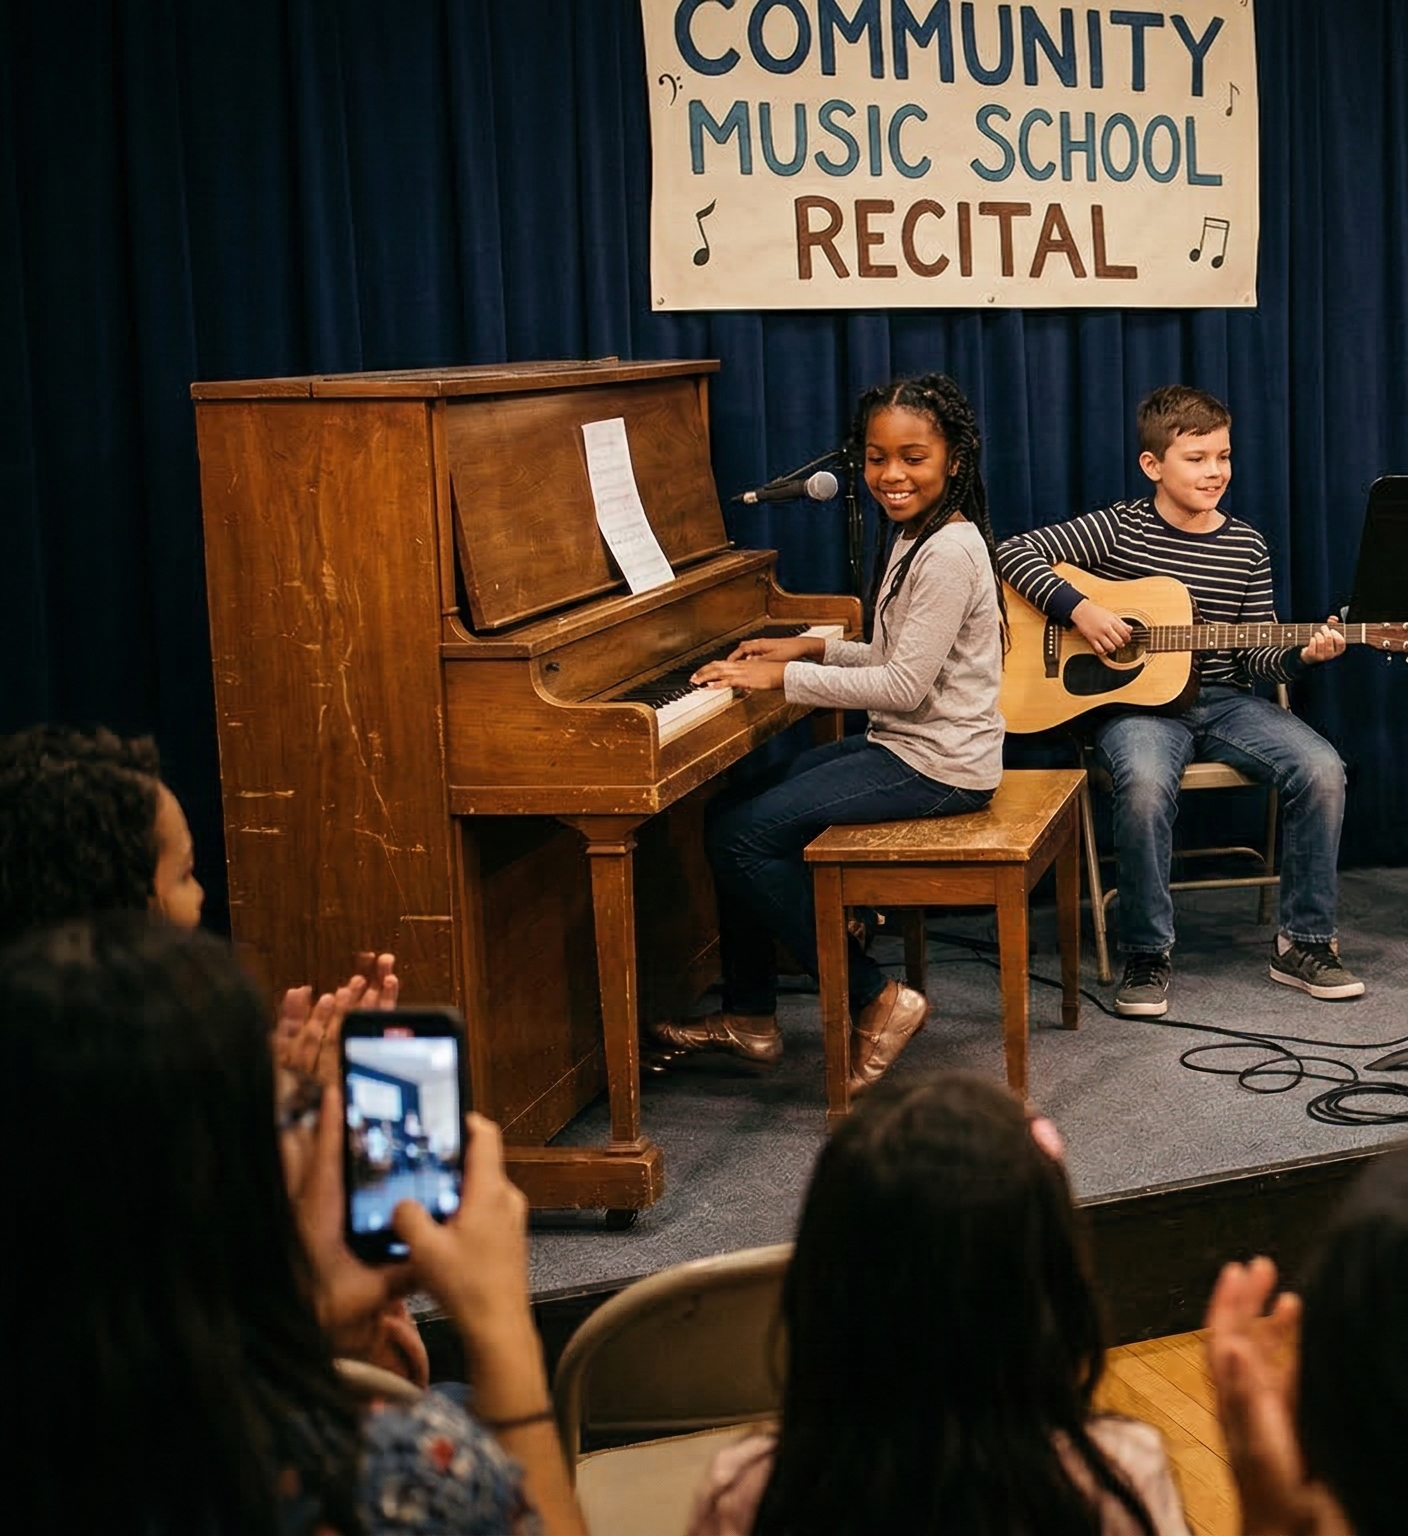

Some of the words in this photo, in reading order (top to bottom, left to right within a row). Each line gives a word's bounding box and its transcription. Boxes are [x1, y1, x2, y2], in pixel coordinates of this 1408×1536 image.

[674, 0, 1224, 97] COMMUNITY
[689, 99, 932, 179] MUSIC
[970, 104, 1223, 186] SCHOOL
[795, 196, 1138, 279] RECITAL
